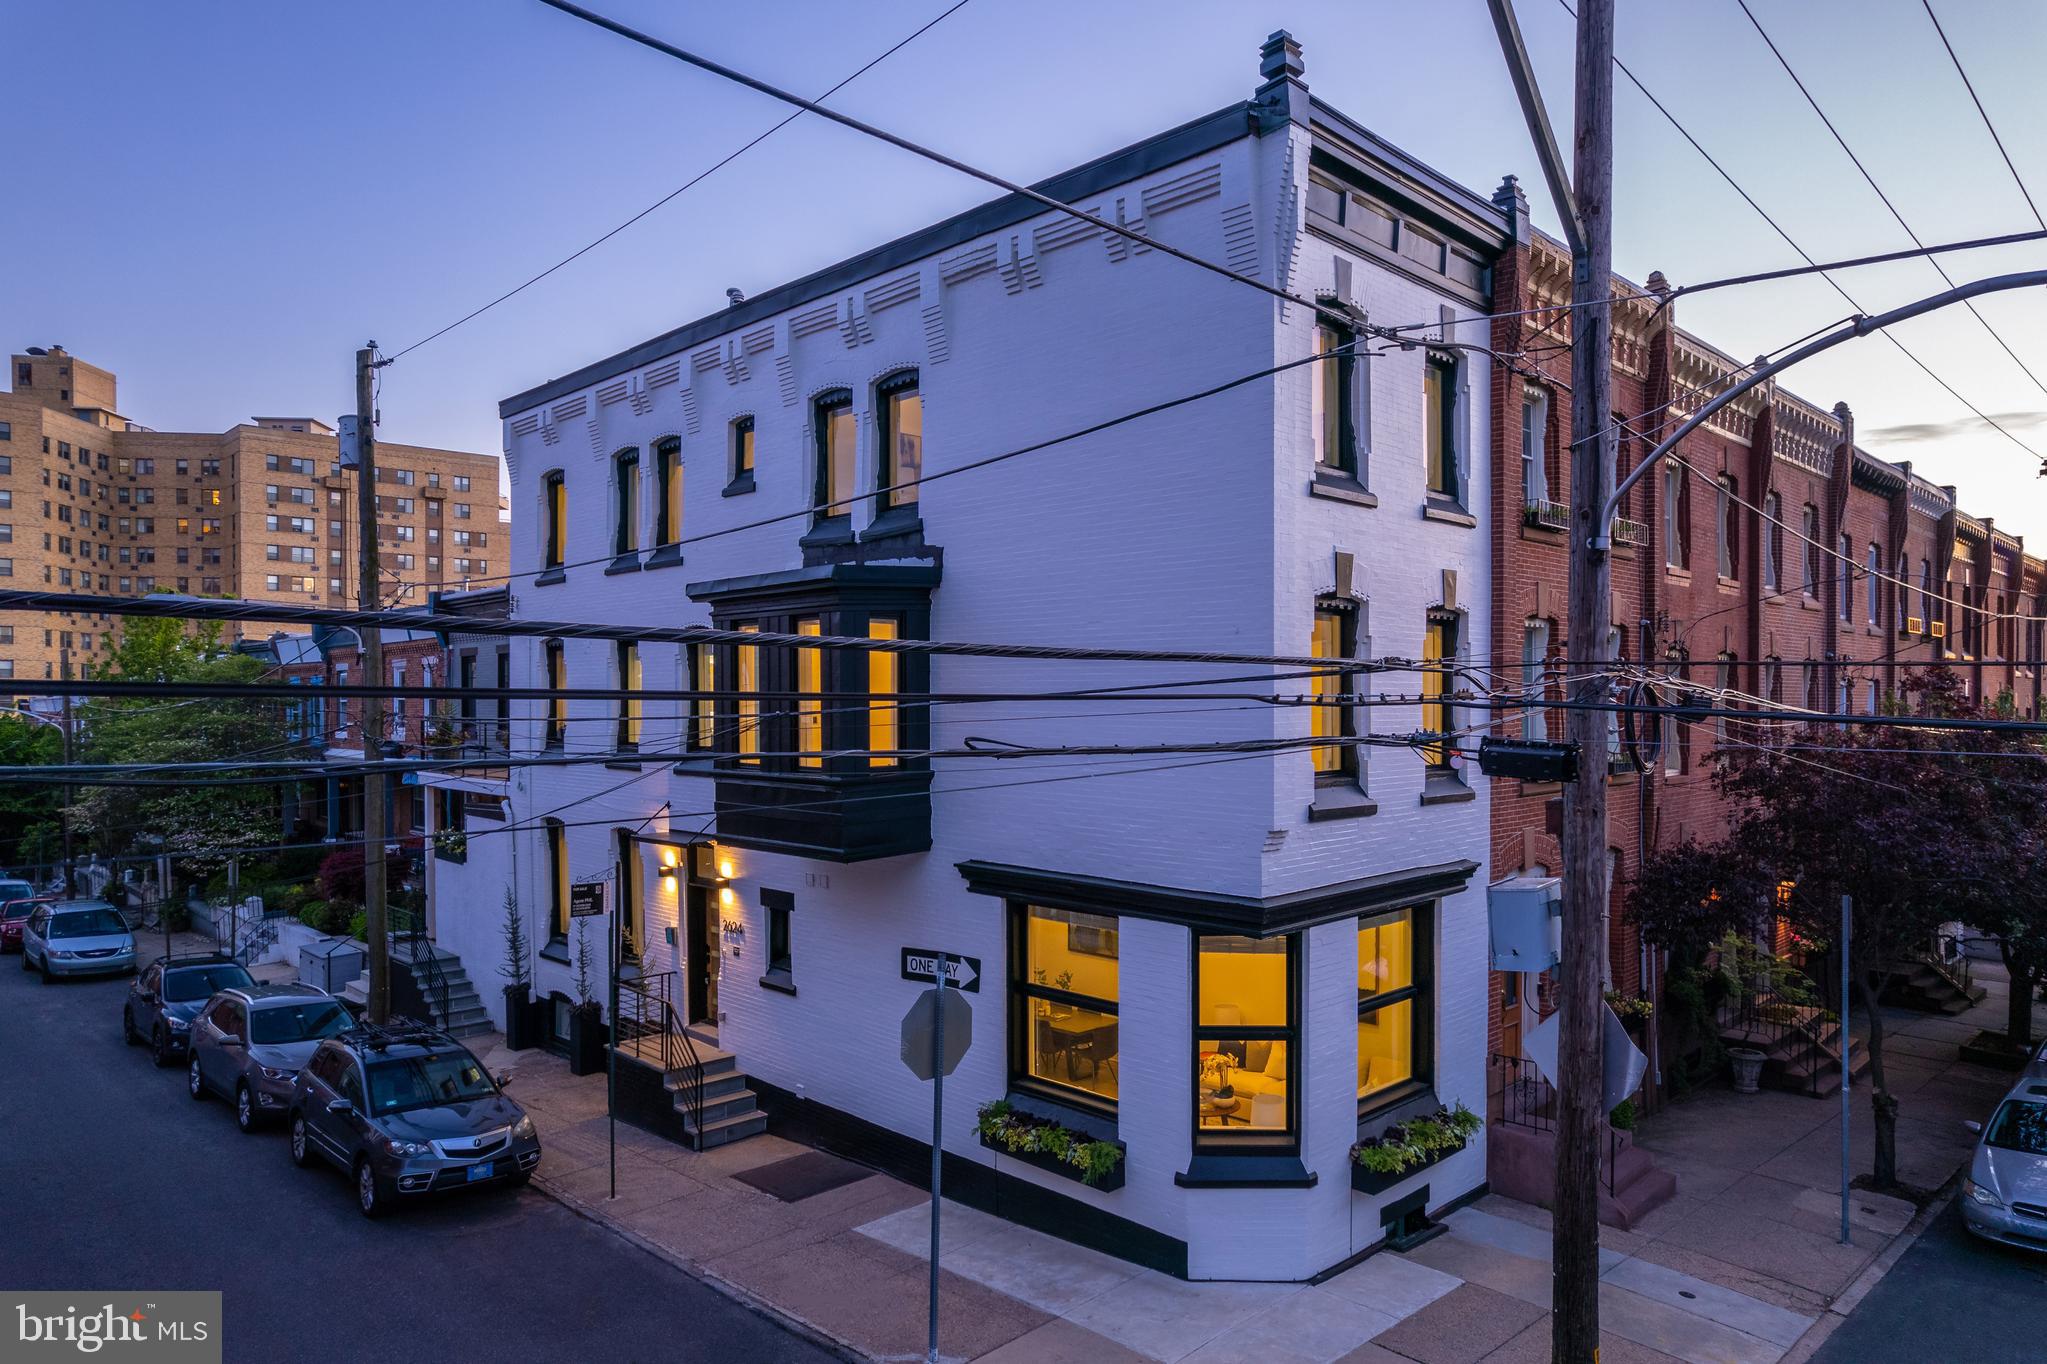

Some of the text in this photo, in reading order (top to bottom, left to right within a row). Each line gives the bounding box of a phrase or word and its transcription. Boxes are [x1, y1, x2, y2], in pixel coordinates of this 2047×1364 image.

[722, 919, 743, 935] 2624
[910, 958, 959, 978] ONE AY
